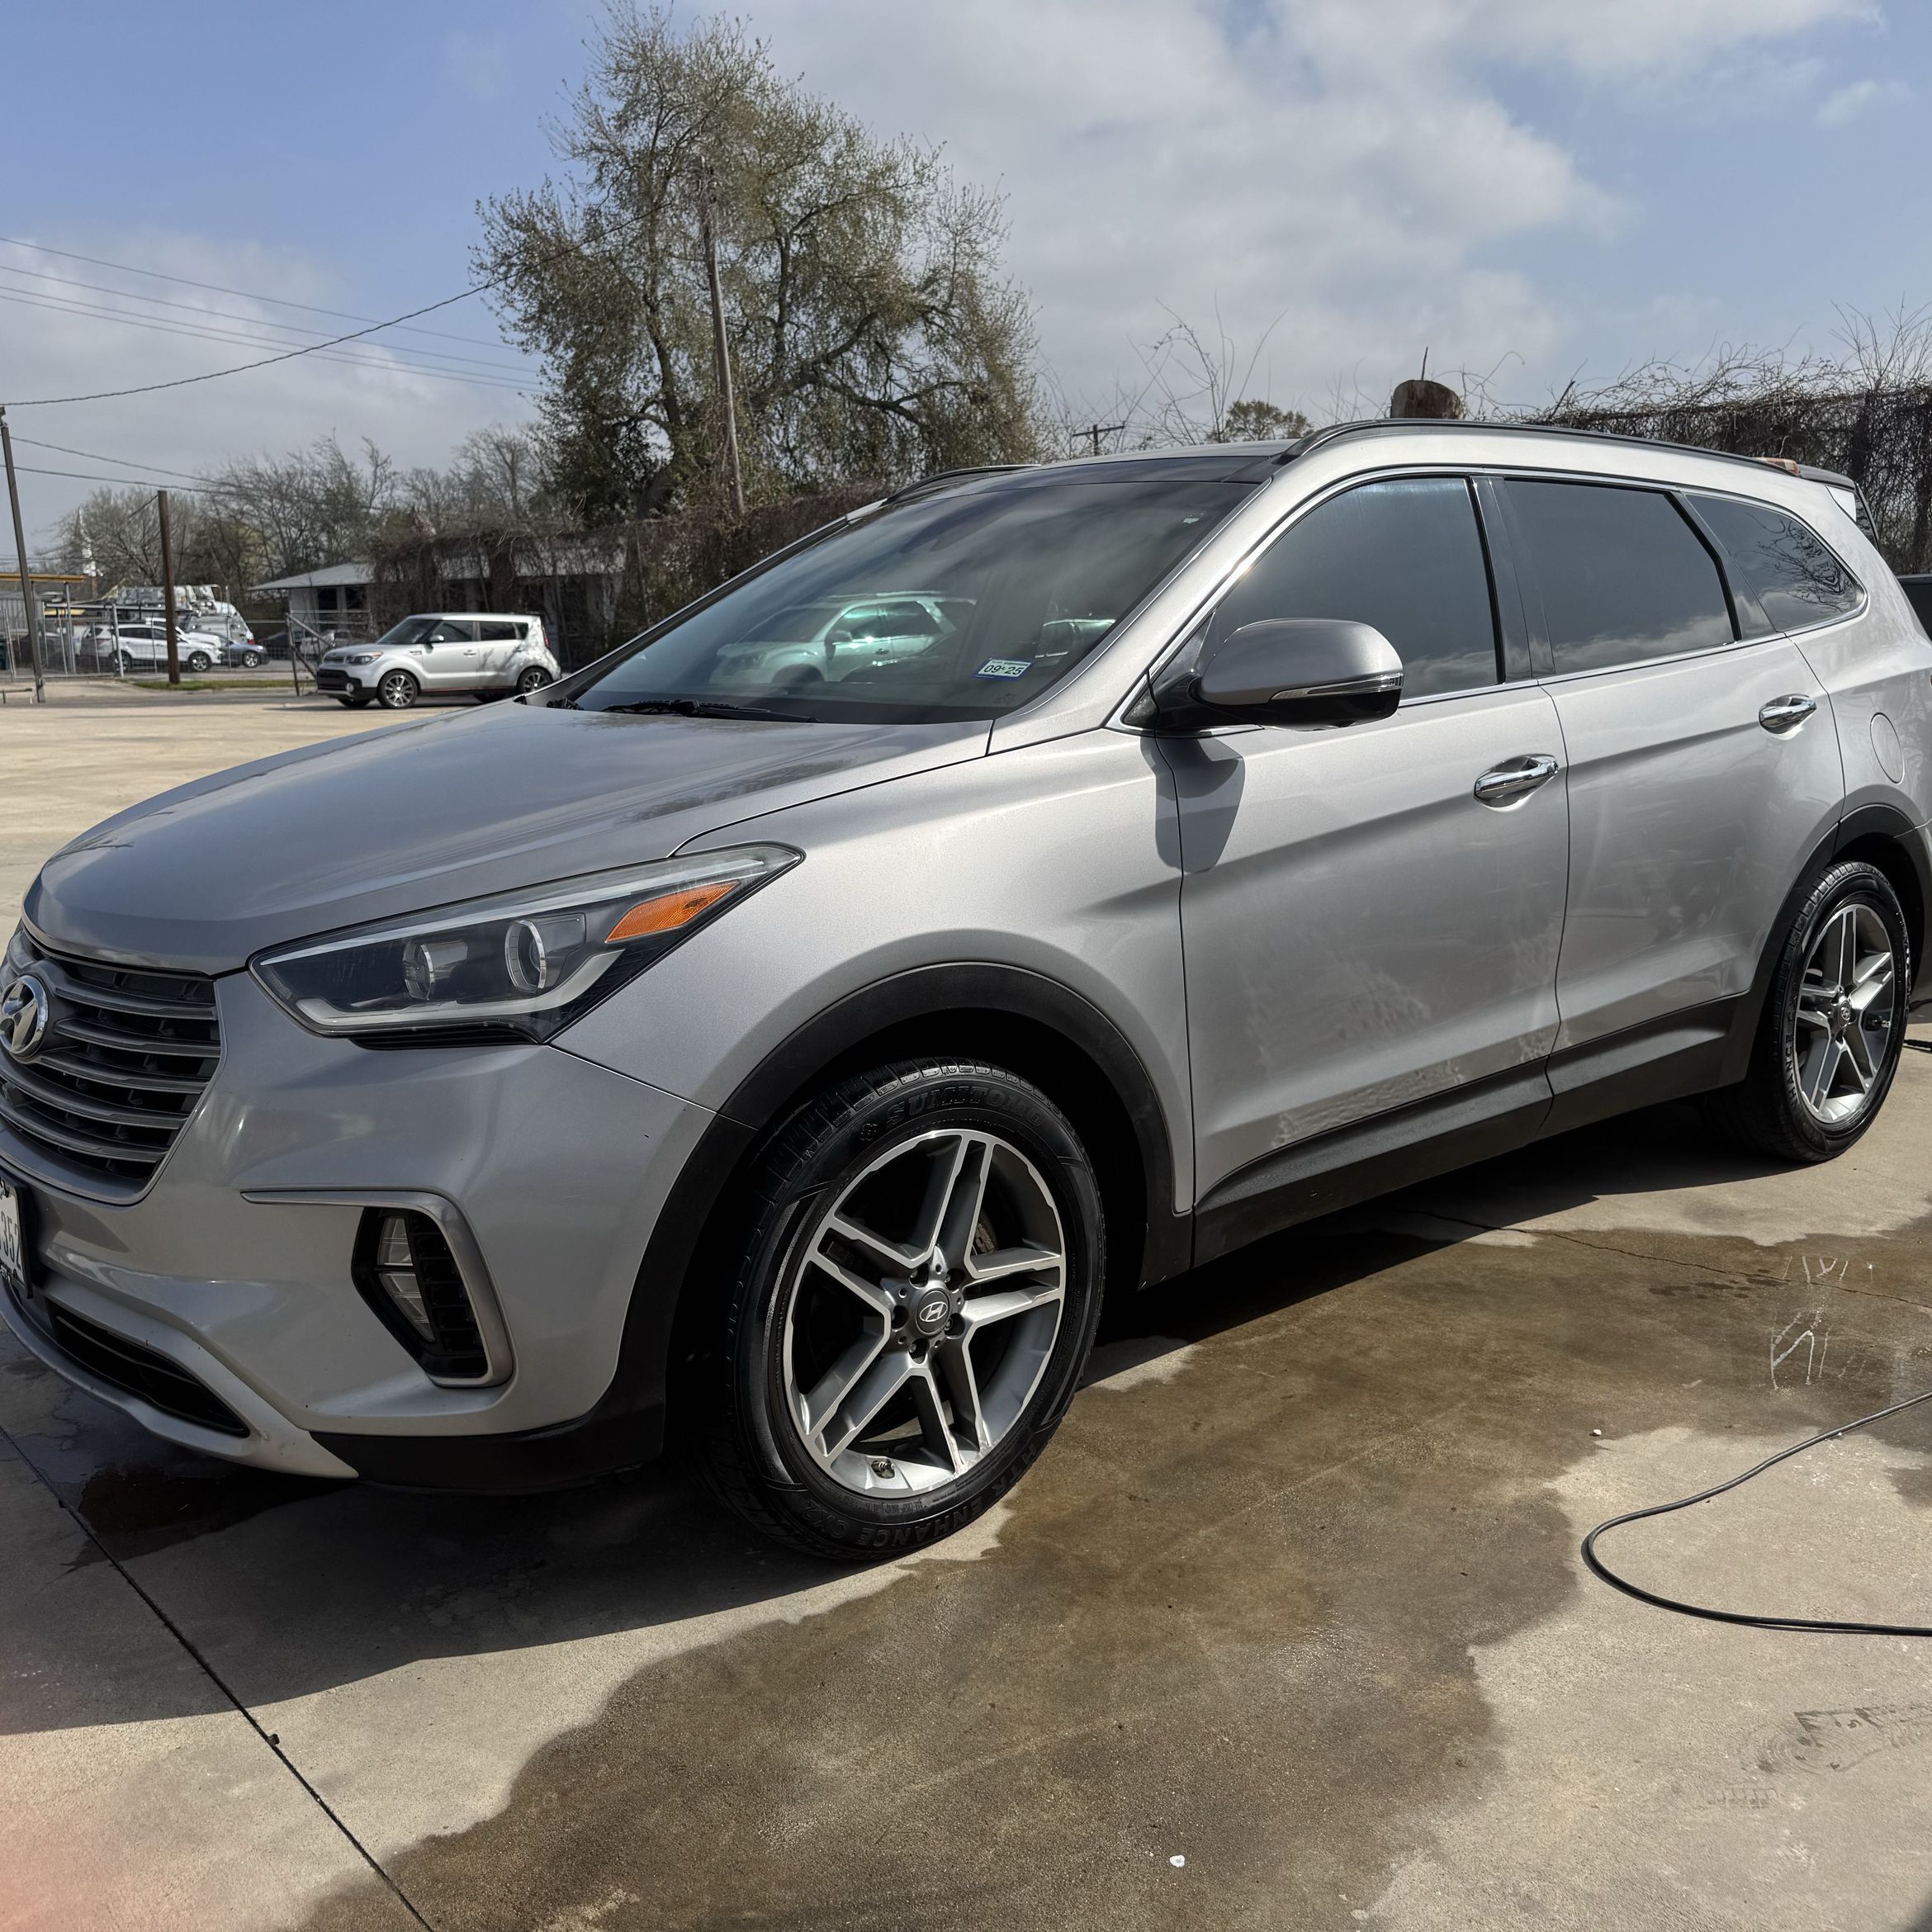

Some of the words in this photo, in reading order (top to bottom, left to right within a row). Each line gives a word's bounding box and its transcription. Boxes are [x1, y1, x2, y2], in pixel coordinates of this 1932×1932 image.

[886, 1085, 1045, 1129] SUMITOMO
[0, 1210, 21, 1270] 352
[855, 1501, 983, 1549] ENHANCE
